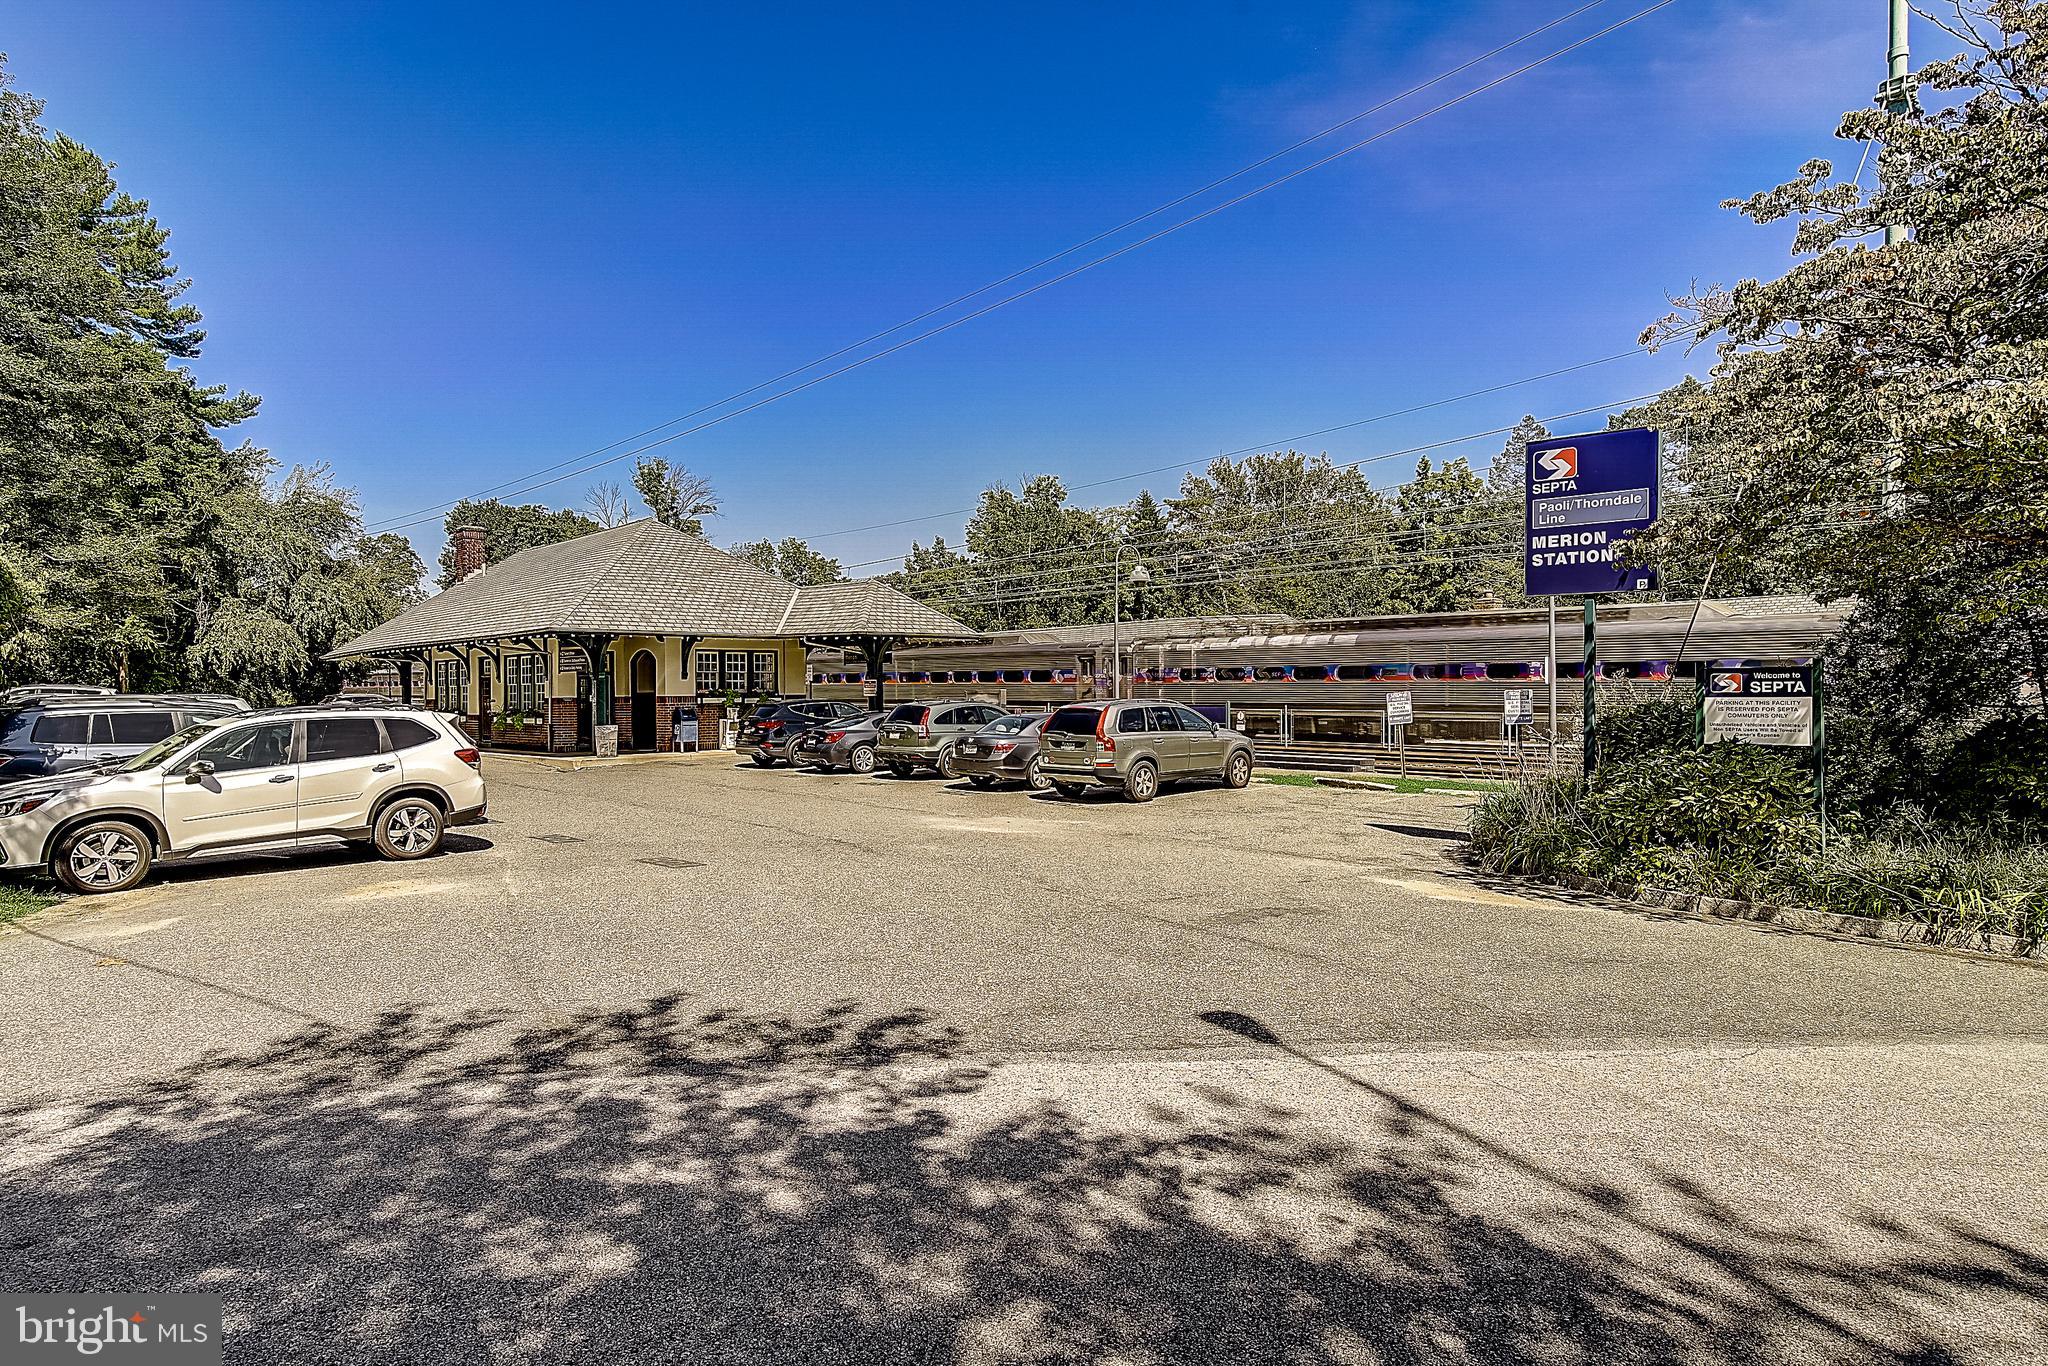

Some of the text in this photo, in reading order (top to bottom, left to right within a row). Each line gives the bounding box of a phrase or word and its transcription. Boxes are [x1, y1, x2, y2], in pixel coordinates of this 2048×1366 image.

[1532, 480, 1577, 495] SEPTA
[1539, 493, 1642, 513] Paoli/Thorndale
[1539, 514, 1566, 525] Line
[1532, 531, 1607, 549] MERION
[1532, 549, 1613, 567] STATION
[1750, 681, 1806, 693] SEPTA
